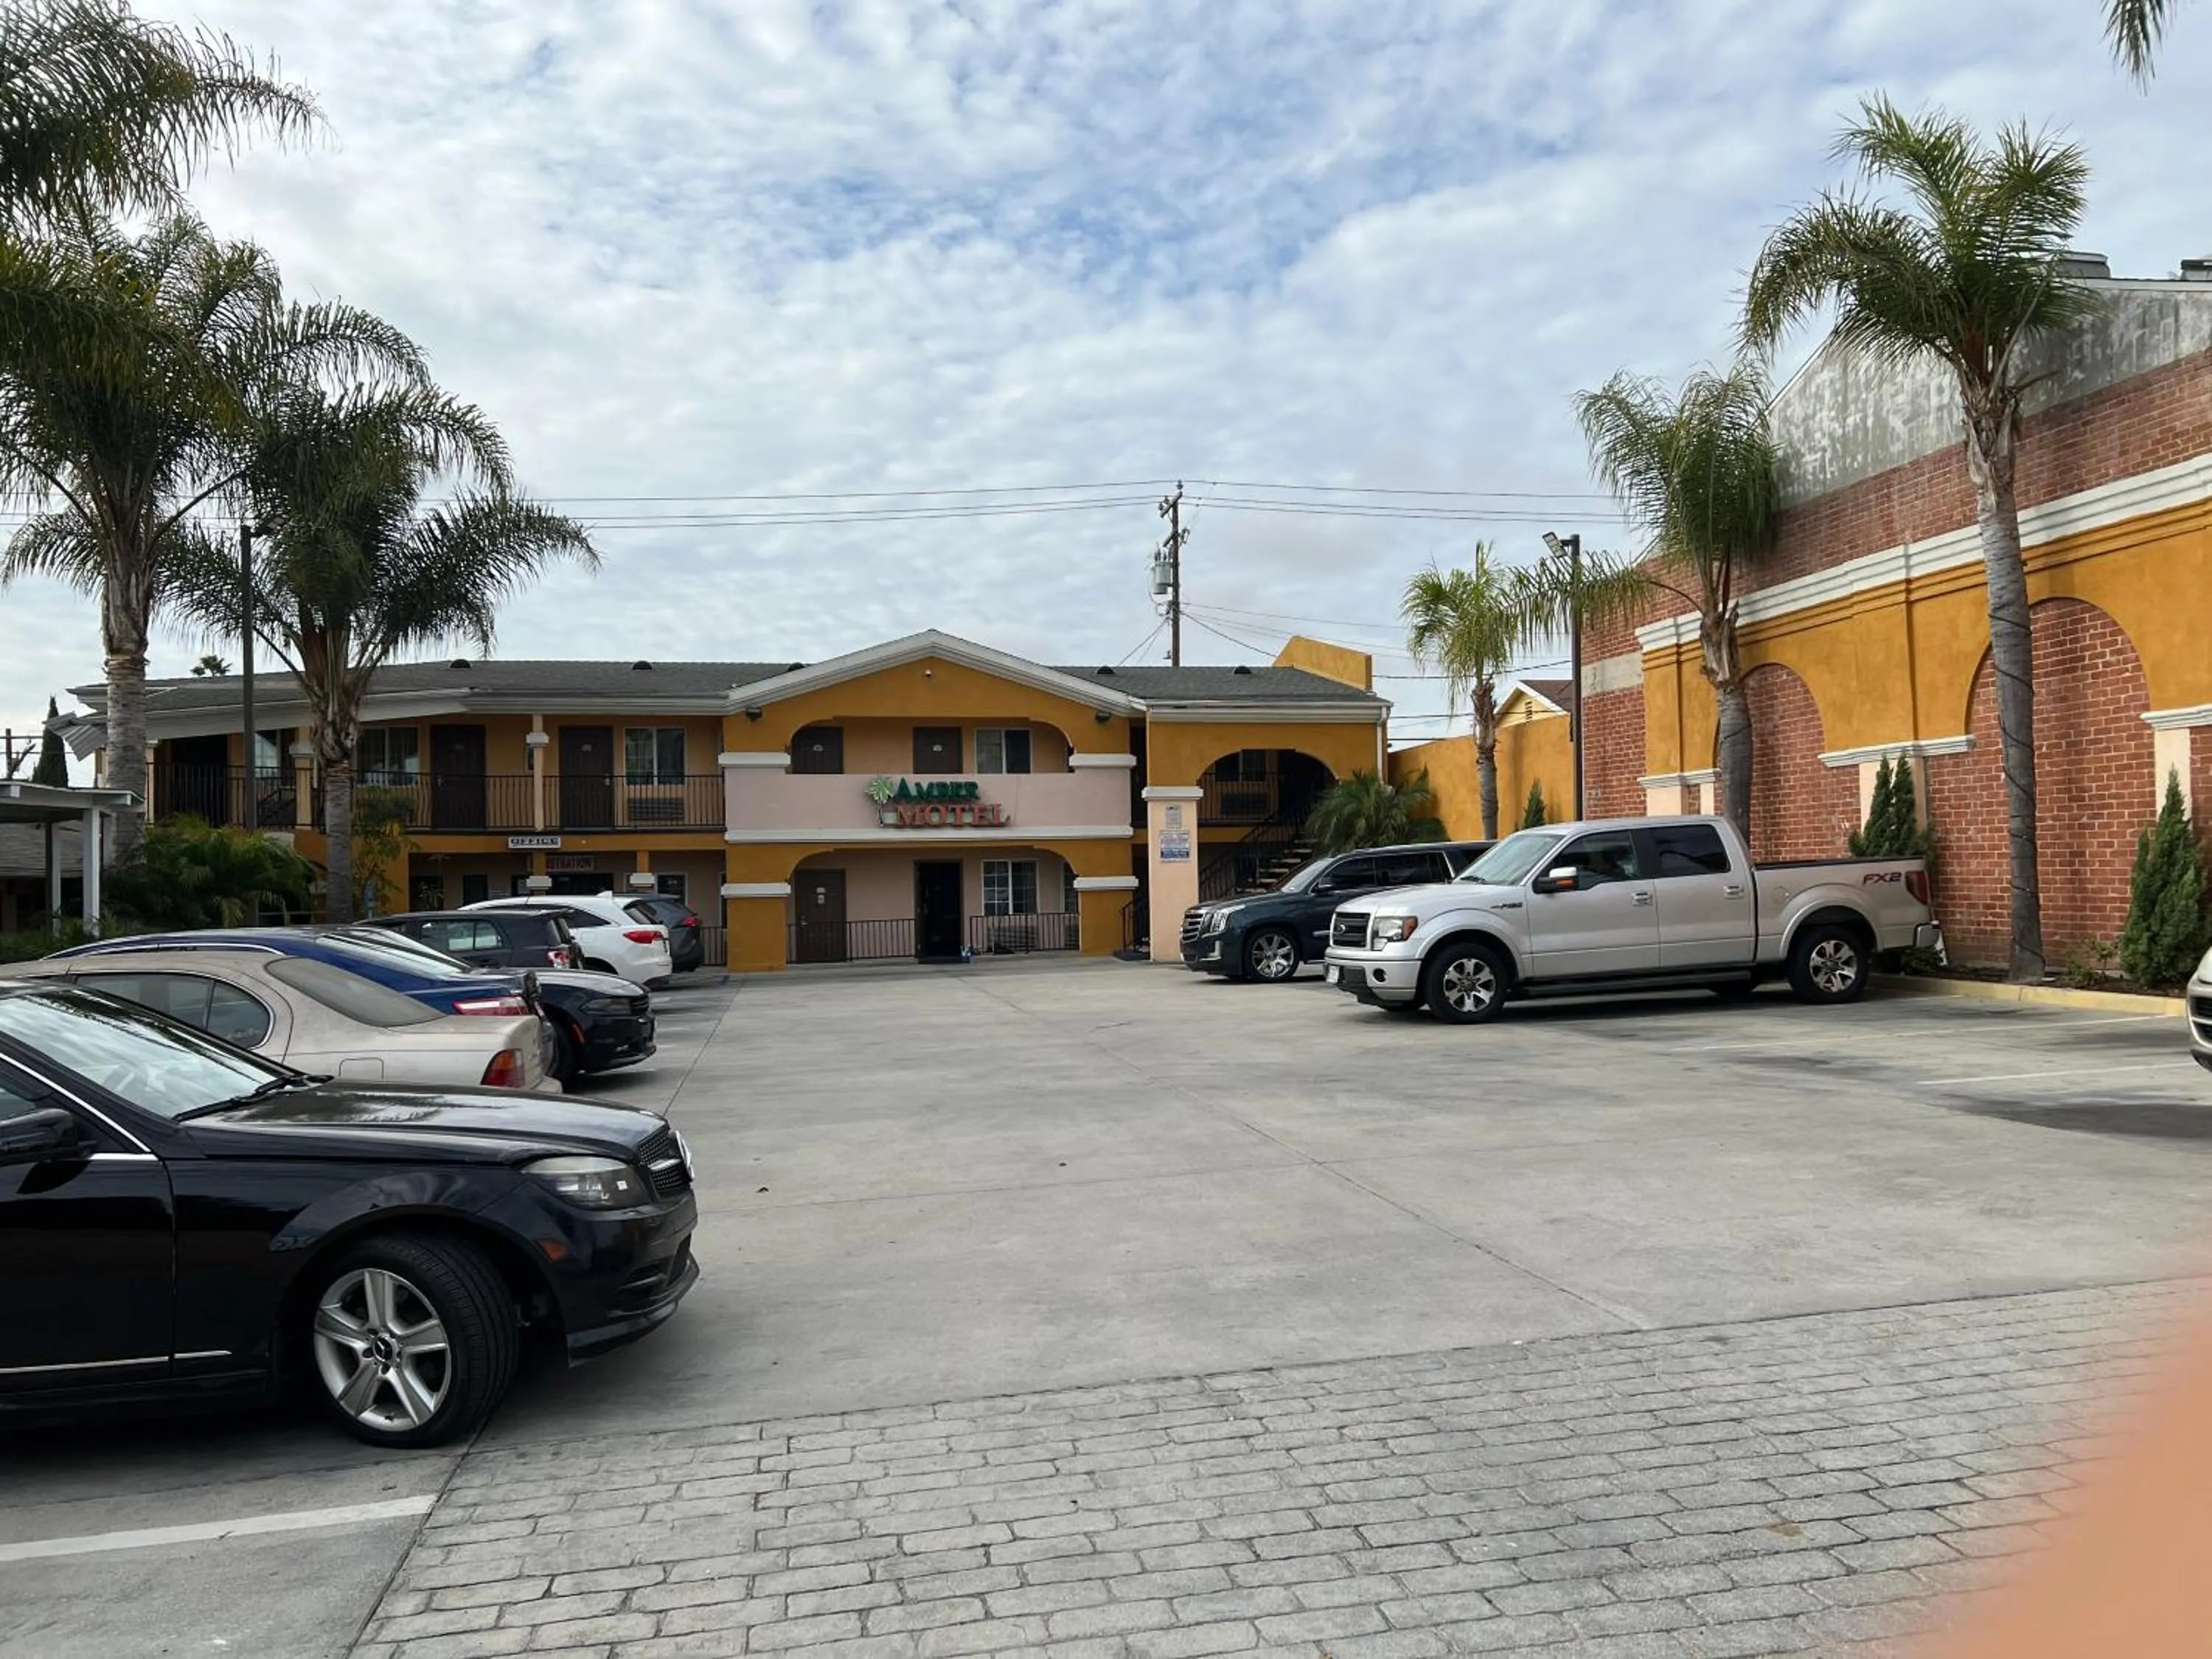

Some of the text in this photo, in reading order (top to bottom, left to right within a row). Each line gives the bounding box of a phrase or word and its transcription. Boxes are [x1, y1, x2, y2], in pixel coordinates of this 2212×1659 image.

[895, 777, 981, 799] AMBER
[897, 803, 1012, 827] MOTEL
[1863, 872, 1902, 884] FX2
